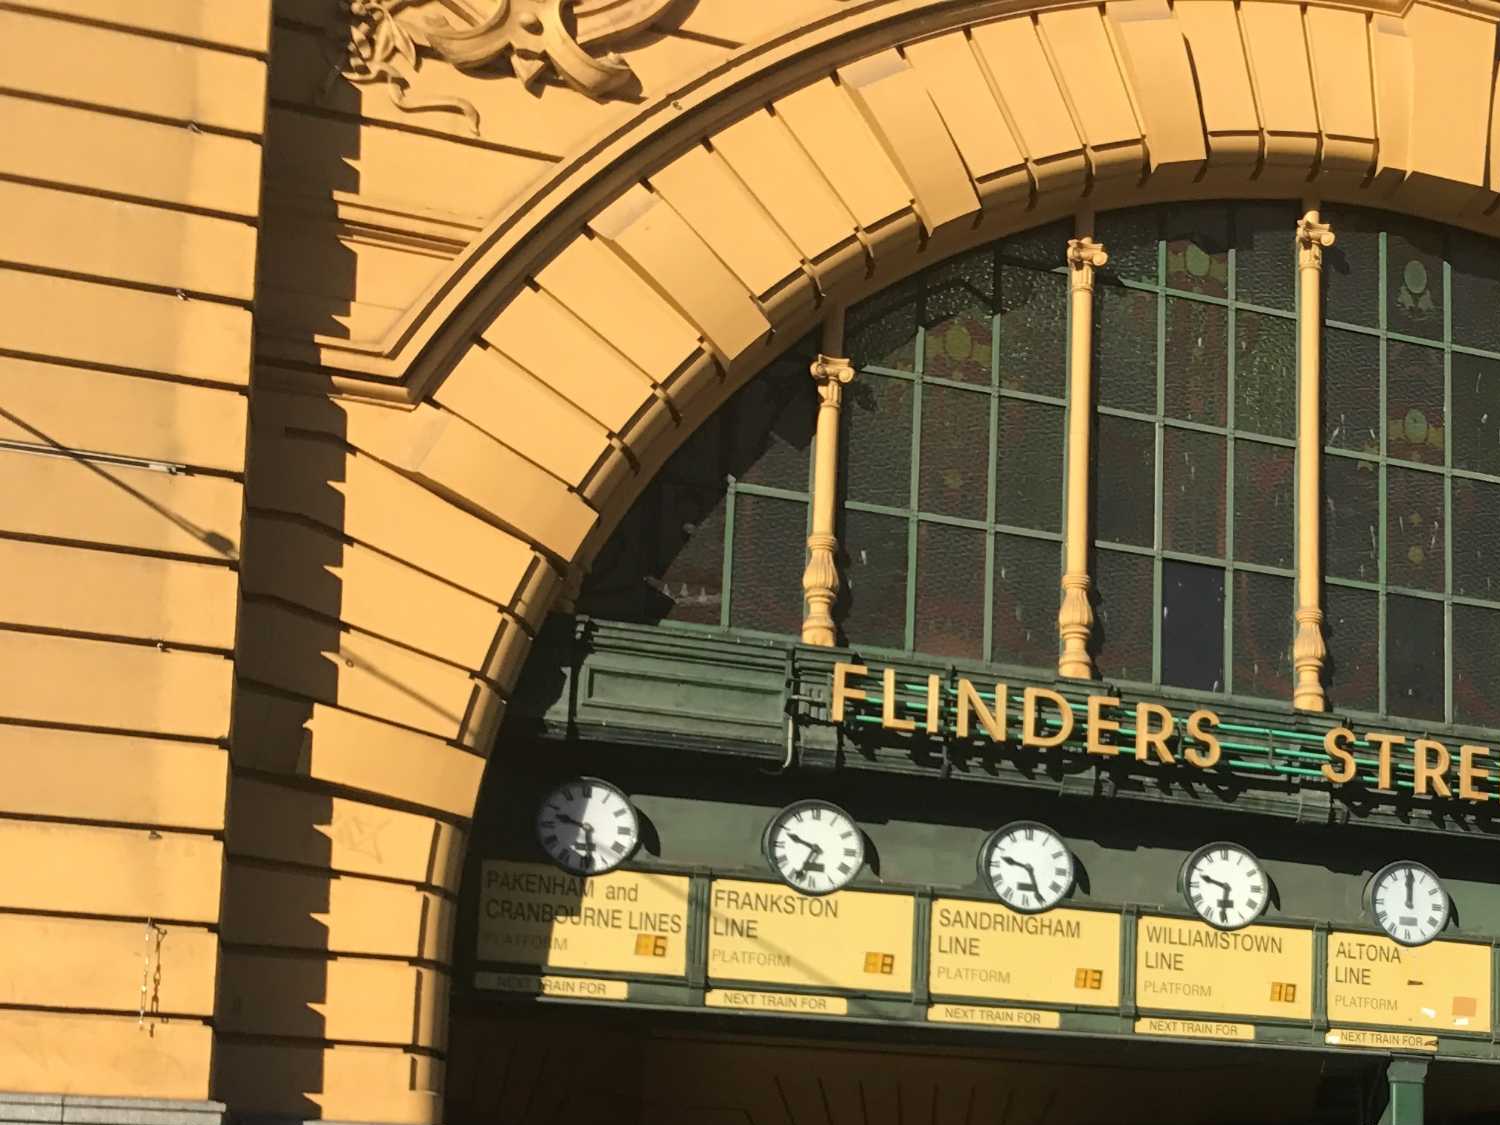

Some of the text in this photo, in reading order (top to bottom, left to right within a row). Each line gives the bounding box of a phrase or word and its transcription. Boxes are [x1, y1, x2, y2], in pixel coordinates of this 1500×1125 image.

[830, 661, 1221, 768] FLINDERS
[487, 871, 638, 902] PAKENHAM and
[714, 889, 838, 918] FRANKSTON
[486, 900, 682, 934] CRANBOURNE LINES
[939, 908, 1081, 938] SANDRINGHAM
[713, 917, 758, 939] LINE
[652, 935, 667, 957] 6
[938, 936, 981, 956] LINE
[1146, 925, 1283, 954] WILLIAMSTOWN
[711, 949, 792, 969] PLATFORM
[1145, 952, 1184, 971] LINE
[1336, 941, 1402, 964] ALTONA
[937, 966, 1011, 984] PLATFORM
[1335, 966, 1371, 985] LINE
[579, 981, 606, 994] FOR
[1144, 980, 1212, 997] PLATFORM
[724, 992, 827, 1010] NEXT TRAIN FOR
[1335, 994, 1398, 1011] PLATFORM
[945, 1007, 1041, 1024] NEXT TRAIN FOR
[1149, 1020, 1238, 1035] NEXT TRAIN FOR
[1340, 1031, 1423, 1046] NEXT TRAIN FOR
